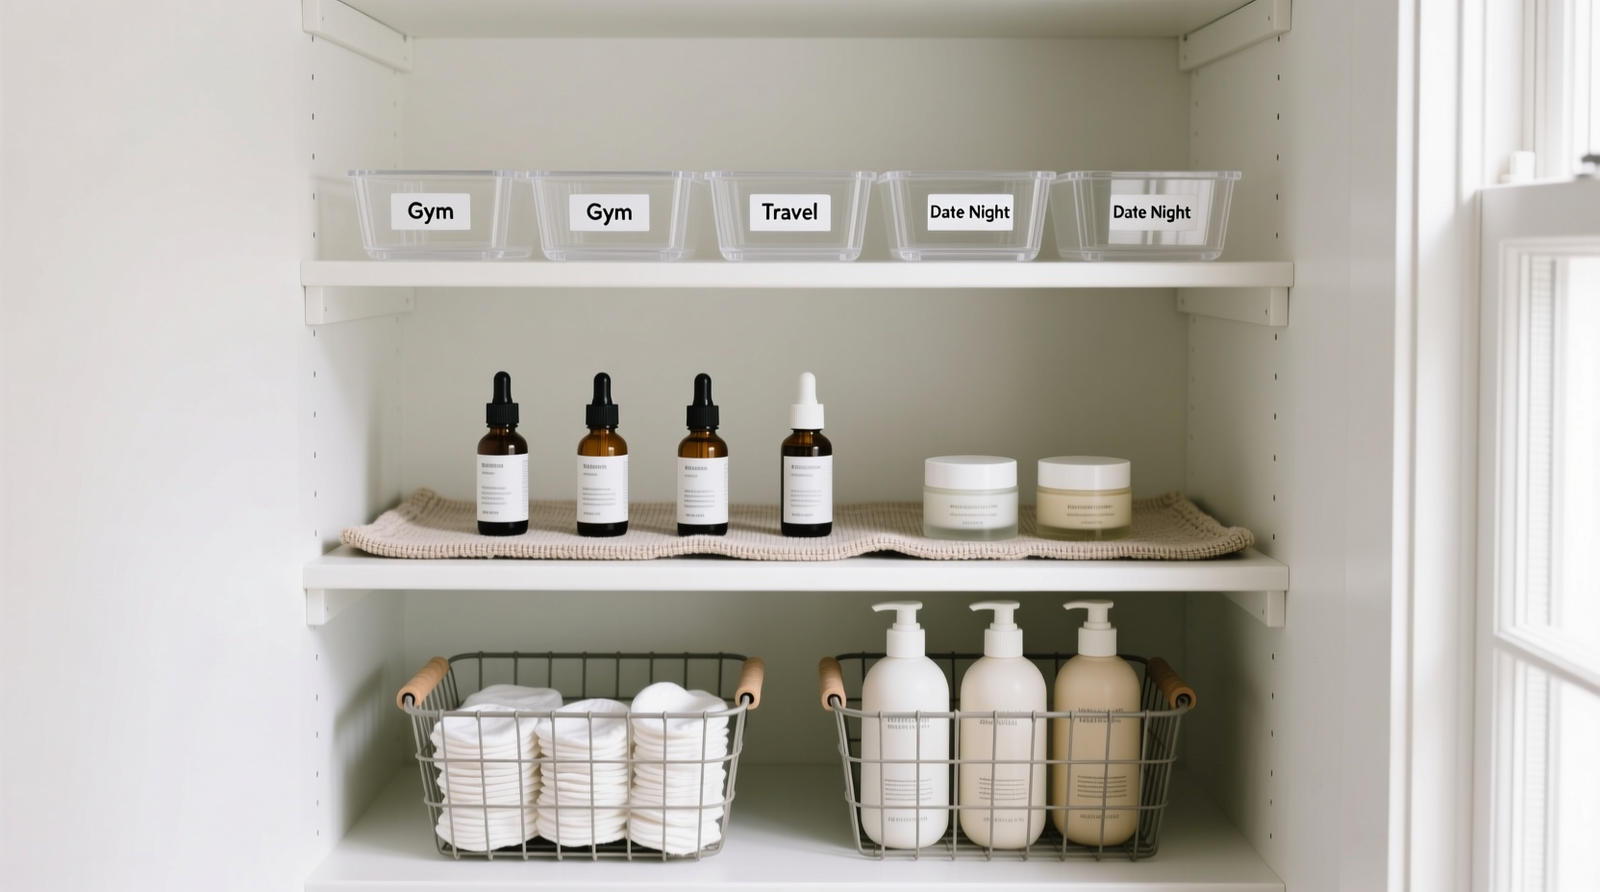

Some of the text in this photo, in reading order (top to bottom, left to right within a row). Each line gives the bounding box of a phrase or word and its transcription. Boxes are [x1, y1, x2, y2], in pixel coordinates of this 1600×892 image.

[407, 202, 454, 225] Gym
[586, 202, 633, 226] Gym
[762, 202, 819, 221] Travel
[930, 204, 1010, 223] Date Night
[1113, 204, 1191, 223] Date Night
